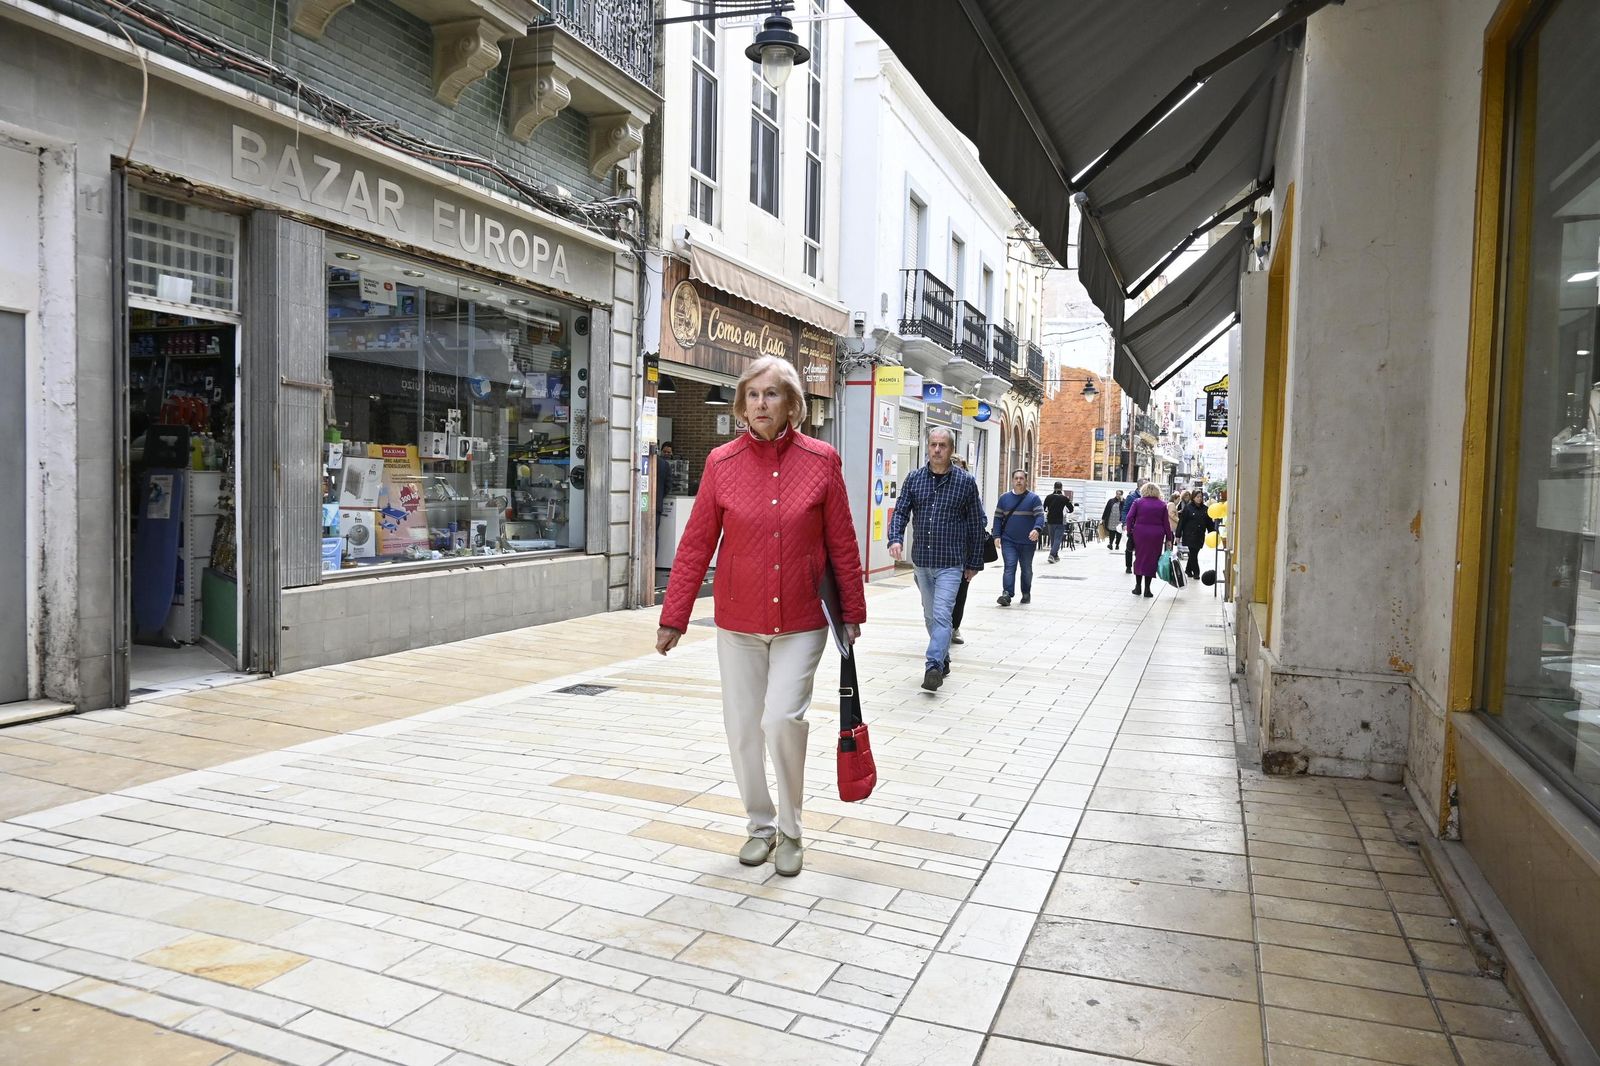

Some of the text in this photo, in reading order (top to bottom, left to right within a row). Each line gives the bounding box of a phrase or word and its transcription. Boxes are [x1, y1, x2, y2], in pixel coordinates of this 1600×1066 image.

[232, 124, 569, 284] BAZAR EUROPA
[708, 307, 786, 357] Como en Casa
